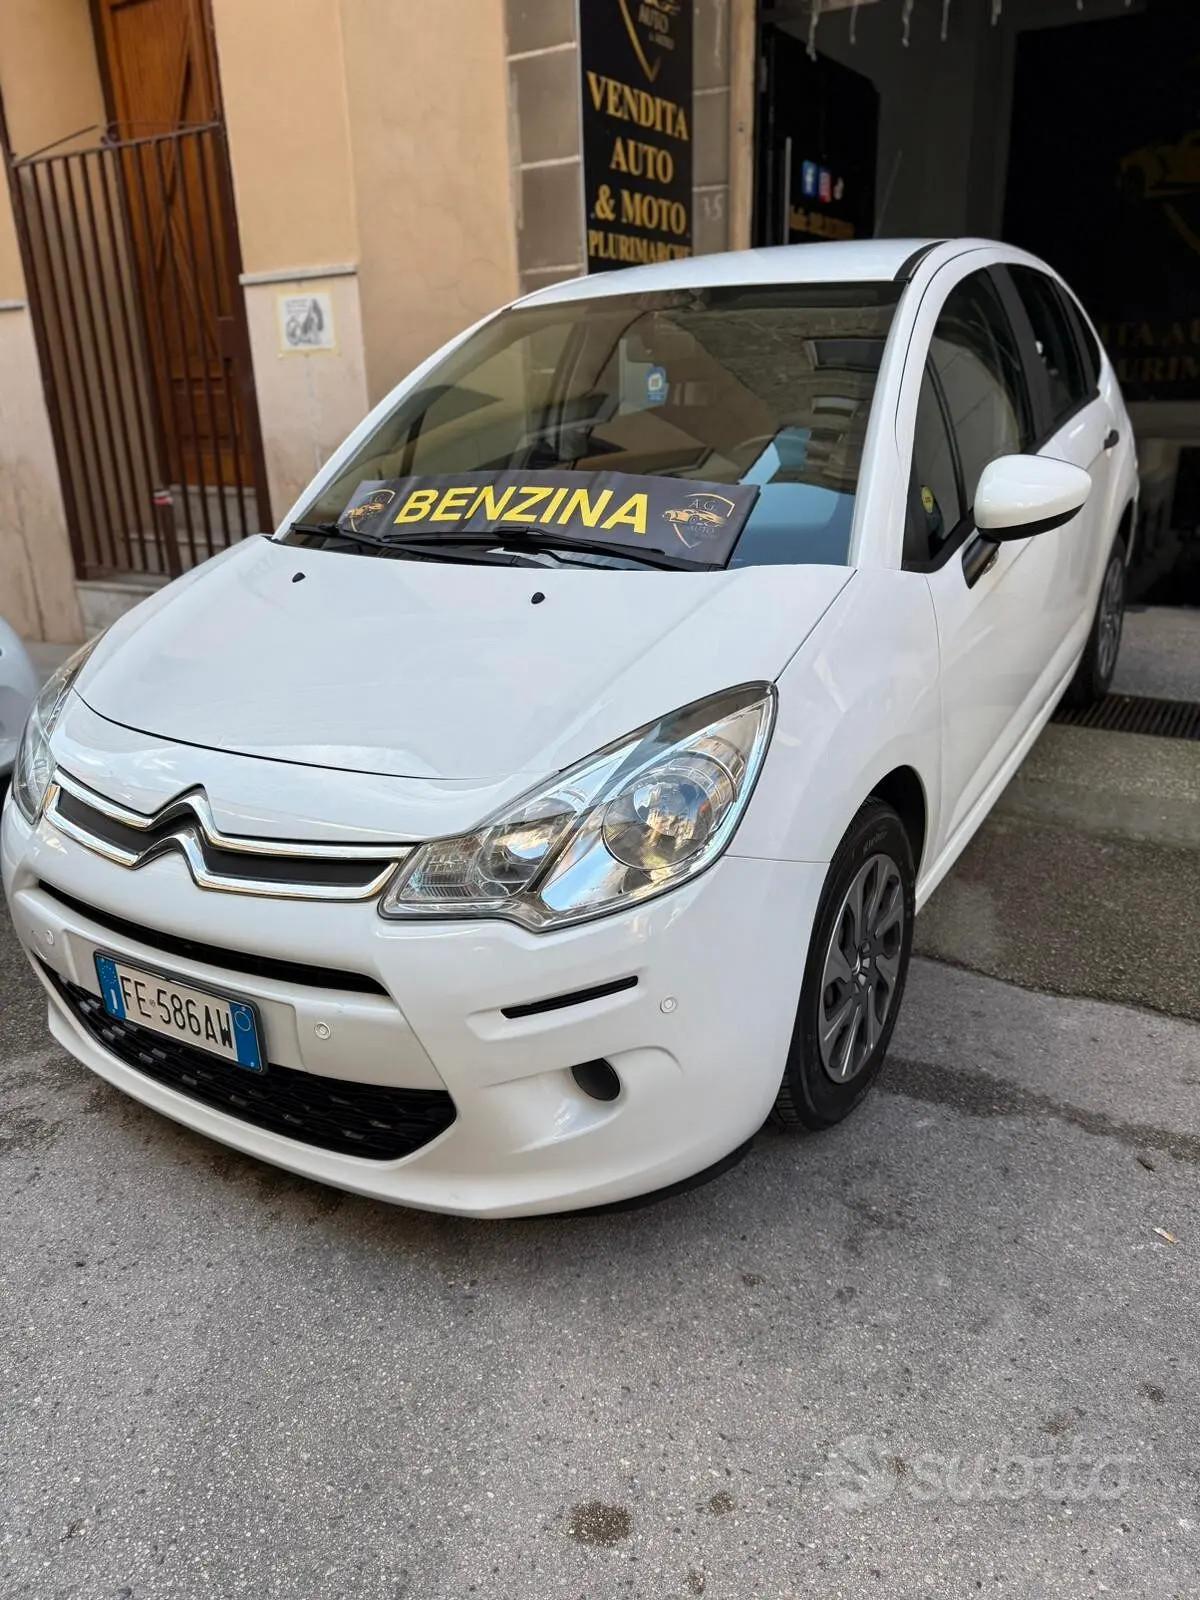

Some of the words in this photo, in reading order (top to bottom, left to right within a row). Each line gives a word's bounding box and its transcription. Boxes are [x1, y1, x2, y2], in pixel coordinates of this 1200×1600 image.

[587, 71, 689, 141] VENDITA
[610, 136, 674, 184] AUTO
[595, 184, 616, 221] &
[621, 189, 686, 235] MOTO
[394, 485, 648, 535] BENZINA
